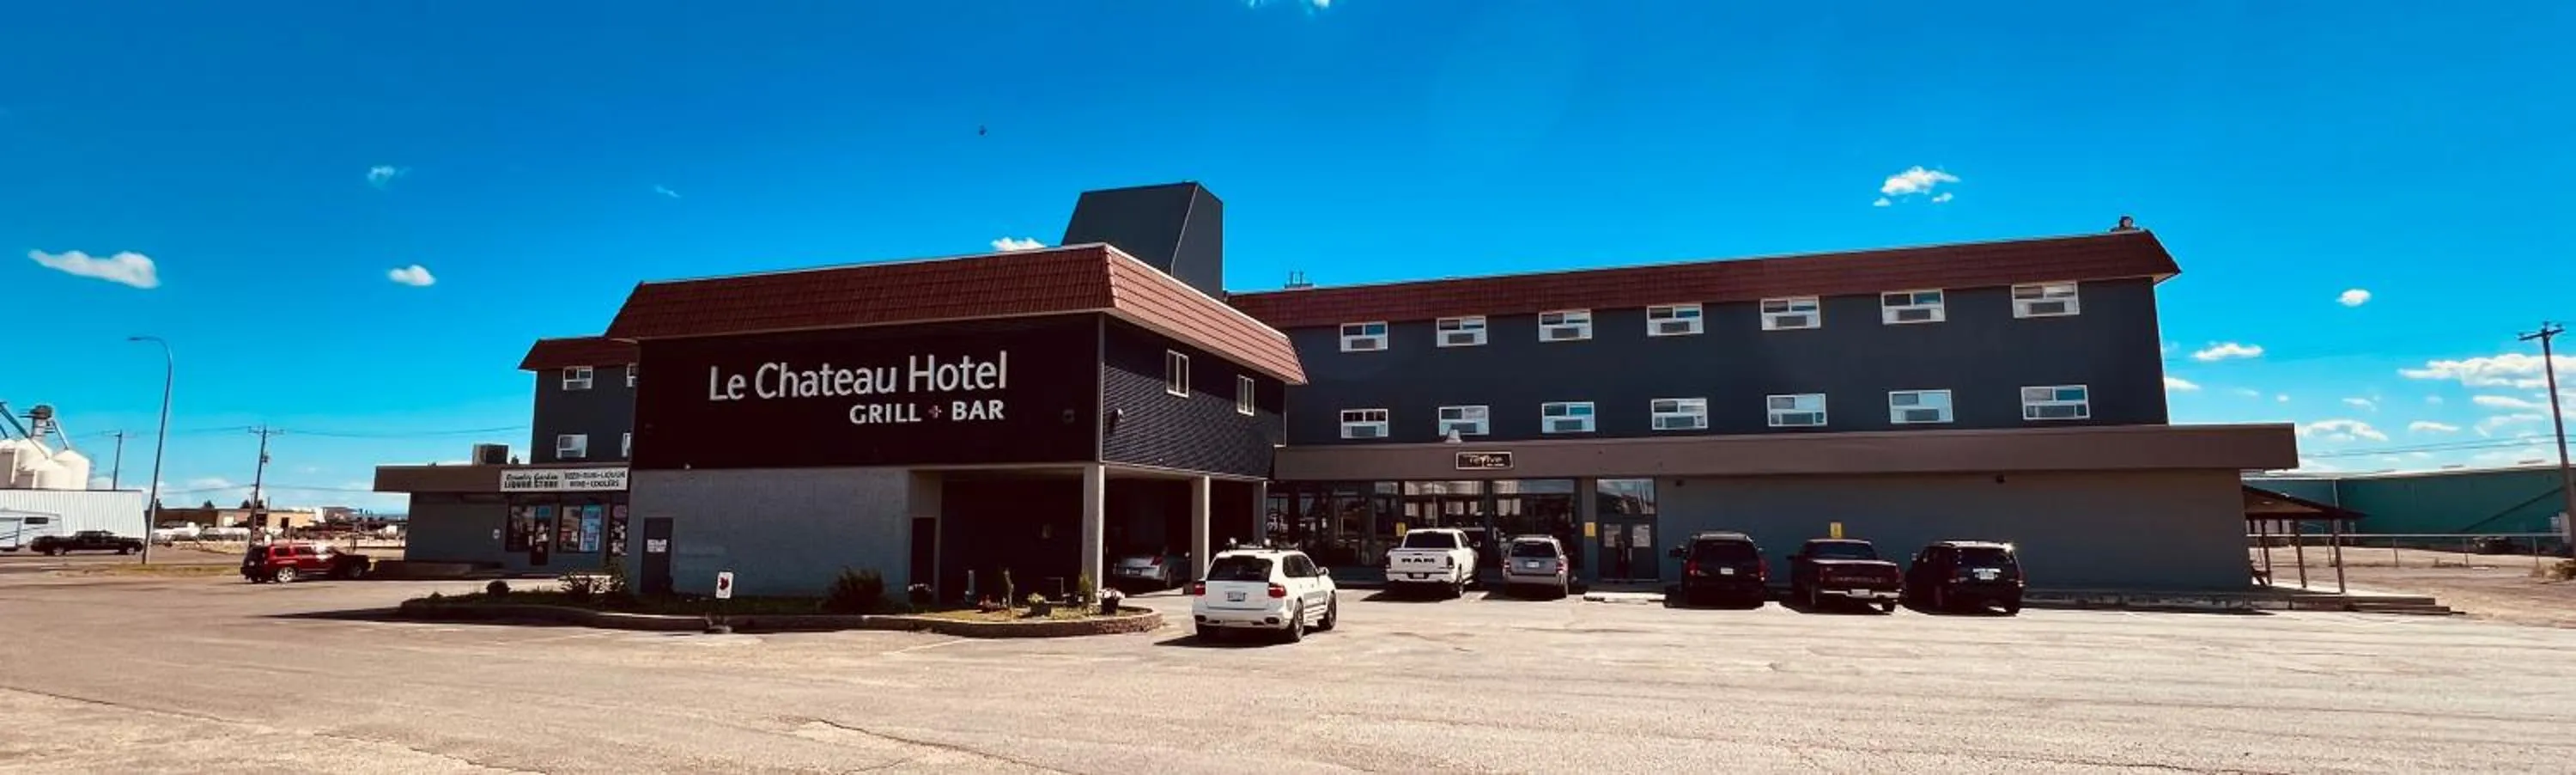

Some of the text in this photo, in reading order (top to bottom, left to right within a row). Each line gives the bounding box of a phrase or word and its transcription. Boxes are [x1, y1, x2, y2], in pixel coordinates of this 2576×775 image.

[709, 350, 1007, 400] Le Chateau Hotel
[849, 403, 922, 424] GRILL
[951, 400, 1005, 421] BAR
